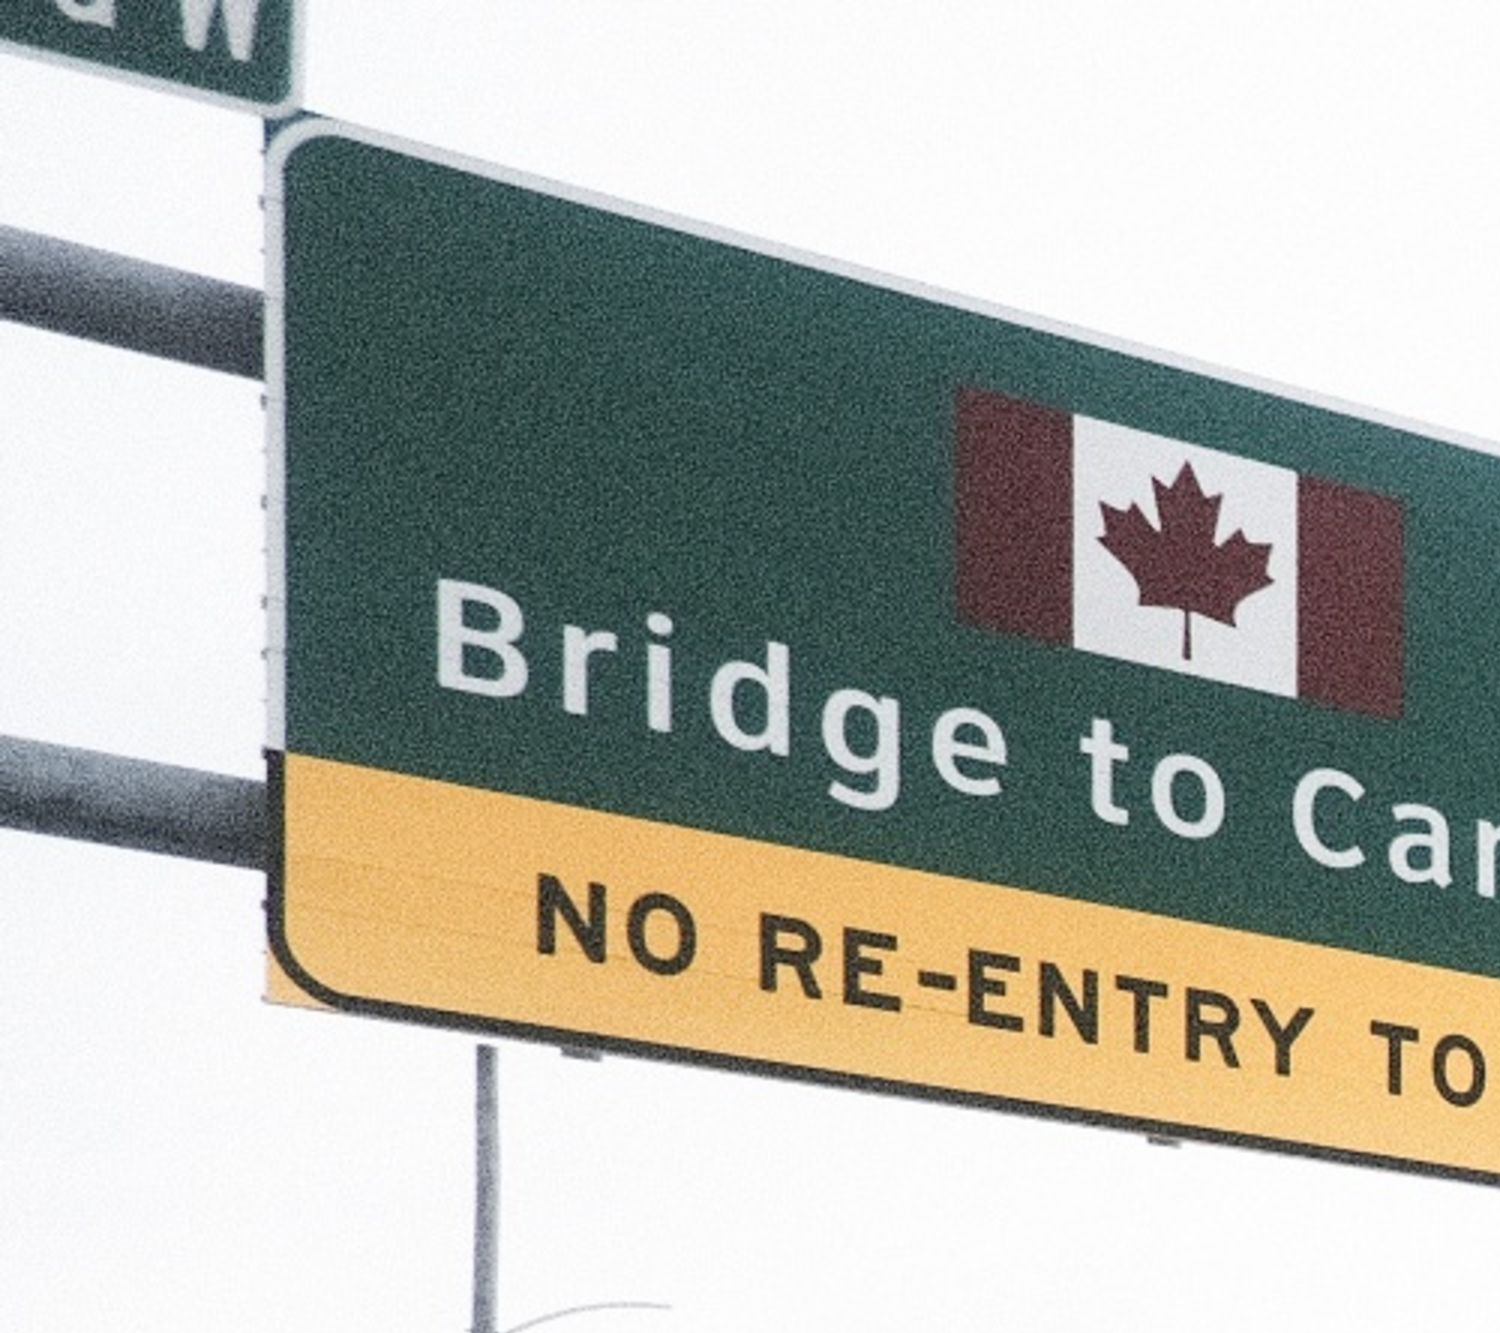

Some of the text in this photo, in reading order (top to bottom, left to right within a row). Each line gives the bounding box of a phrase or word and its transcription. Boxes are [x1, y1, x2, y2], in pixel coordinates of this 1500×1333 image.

[437, 578, 1008, 812] Bridge
[1080, 717, 1226, 840] to
[535, 872, 697, 977] NO
[758, 911, 1315, 1078] RE-ENTRY
[1369, 1019, 1487, 1108] TO
